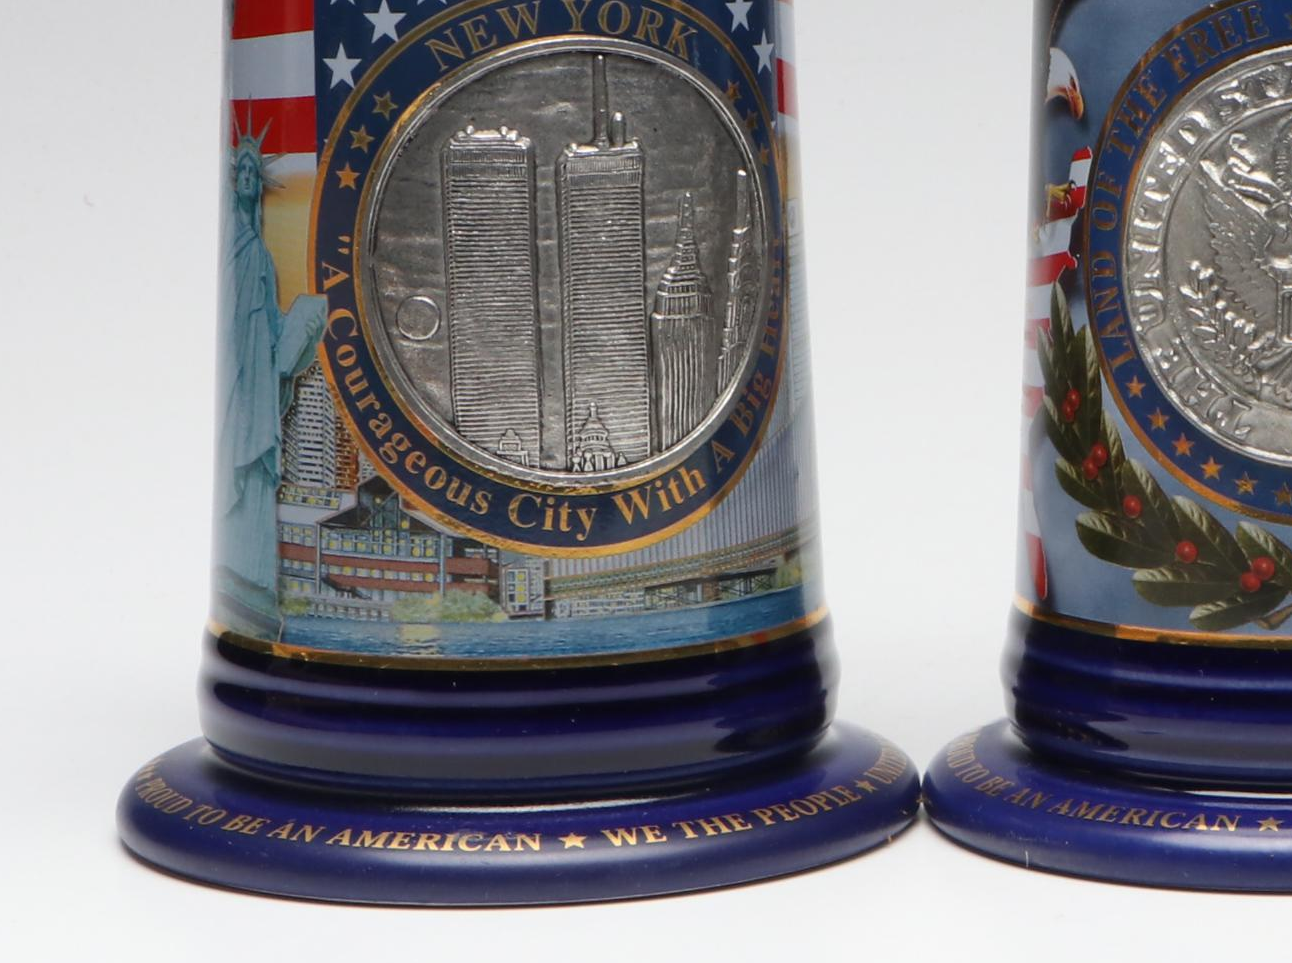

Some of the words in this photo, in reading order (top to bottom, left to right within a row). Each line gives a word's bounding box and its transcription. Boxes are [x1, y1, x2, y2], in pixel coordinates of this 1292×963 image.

[1162, 3, 1271, 84] FREE
[1106, 69, 1168, 161] THE
[1091, 170, 1124, 232] OF
[1130, 110, 1213, 334] UNITED
[1091, 250, 1138, 372] LAND
[324, 307, 493, 517] Courageous
[507, 491, 598, 541] City
[614, 467, 707, 527] With
[709, 443, 736, 475] A
[735, 370, 772, 436] Big
[1153, 337, 1252, 443] THE
[136, 777, 194, 814] PROUD
[182, 803, 229, 826] TO
[222, 813, 272, 836] BE
[266, 817, 326, 844] AN
[325, 828, 542, 853] AMERICAN
[600, 824, 668, 848] WE
[671, 812, 754, 841] THE
[748, 783, 863, 828] PEOPLE
[954, 762, 991, 783] TO
[973, 776, 1017, 797] BE
[1002, 787, 1054, 810] AN
[1046, 799, 1241, 833] AMERICAN
